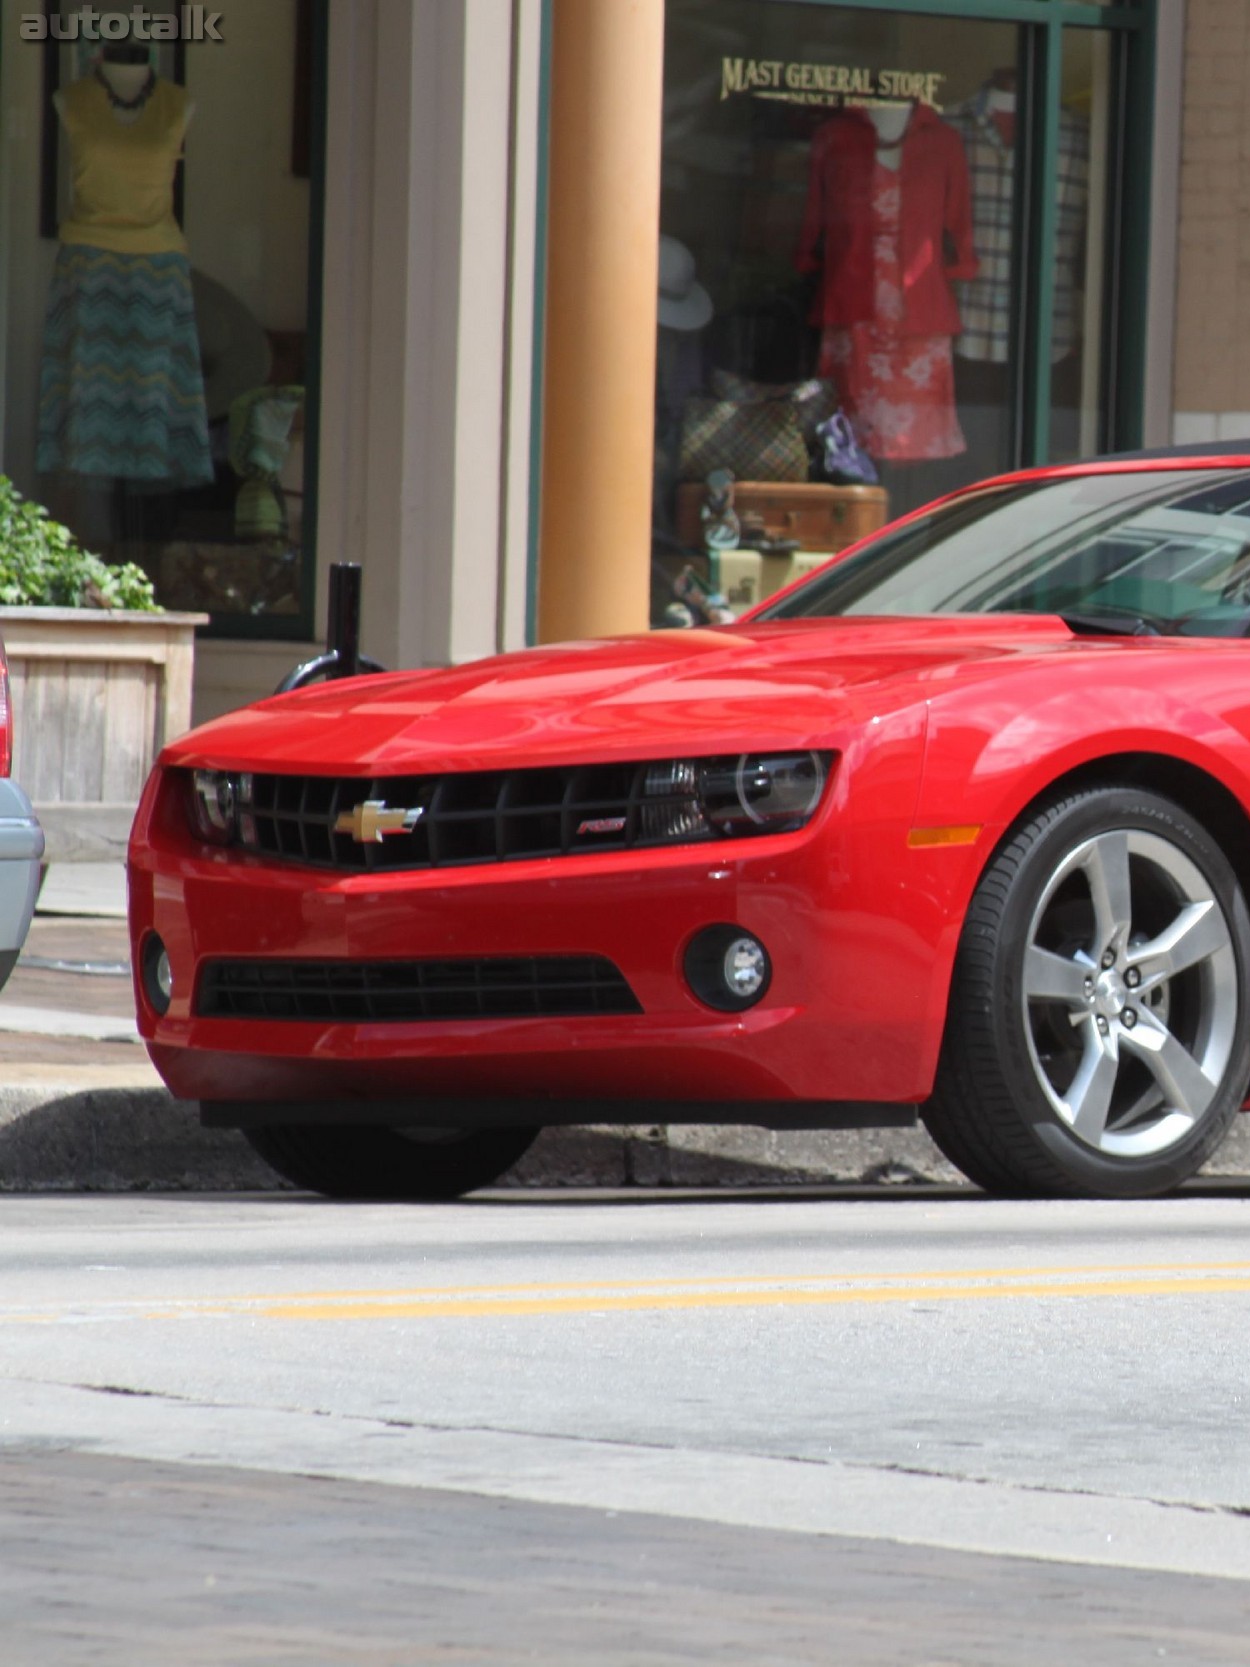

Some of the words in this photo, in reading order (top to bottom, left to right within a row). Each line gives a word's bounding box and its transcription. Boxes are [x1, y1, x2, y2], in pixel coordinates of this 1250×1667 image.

[720, 57, 784, 100] MAST
[785, 62, 874, 95] GENERAL
[878, 69, 944, 113] STORE
